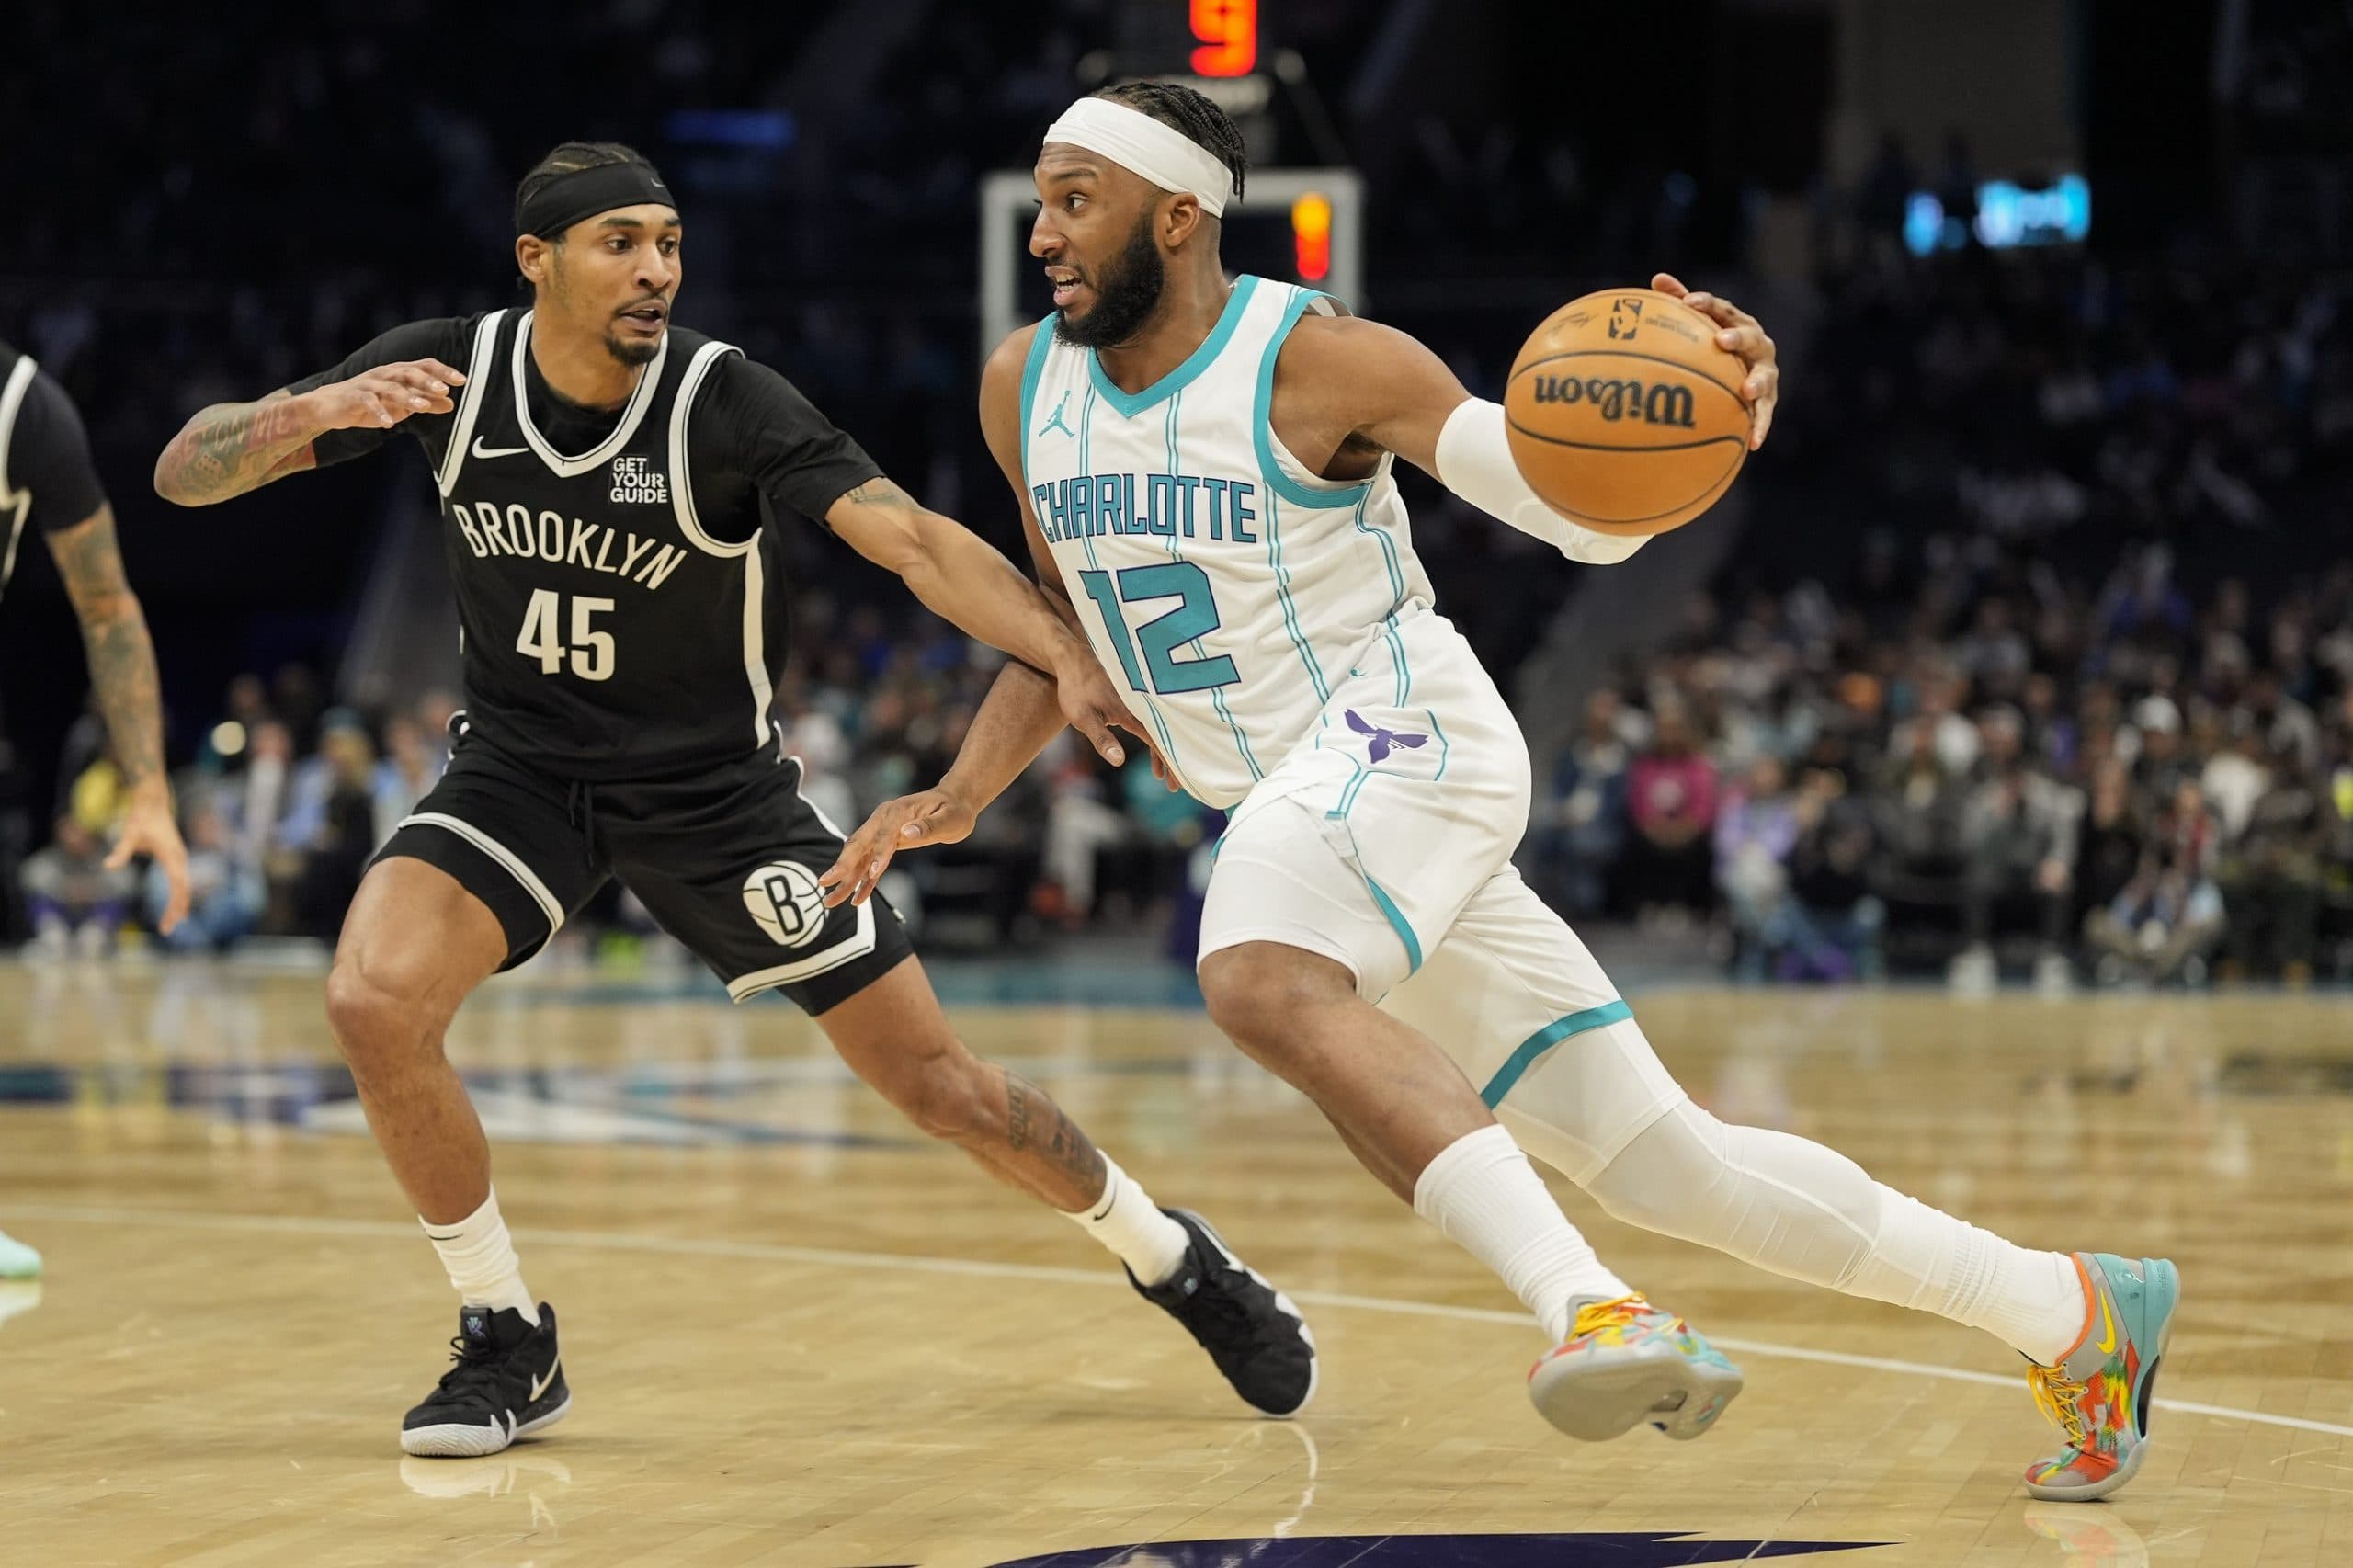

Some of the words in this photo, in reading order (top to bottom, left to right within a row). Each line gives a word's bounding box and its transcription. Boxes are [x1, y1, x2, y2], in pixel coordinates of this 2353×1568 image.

[1535, 374, 1696, 428] Wilson
[610, 487, 667, 503] GUIDE
[612, 472, 664, 488] YOUR
[613, 457, 647, 472] GET
[1032, 473, 1257, 544] CHARLOTTE
[452, 502, 688, 590] BROOKLYN
[516, 588, 615, 681] 45
[1078, 561, 1241, 695] 12
[764, 875, 803, 937] B
